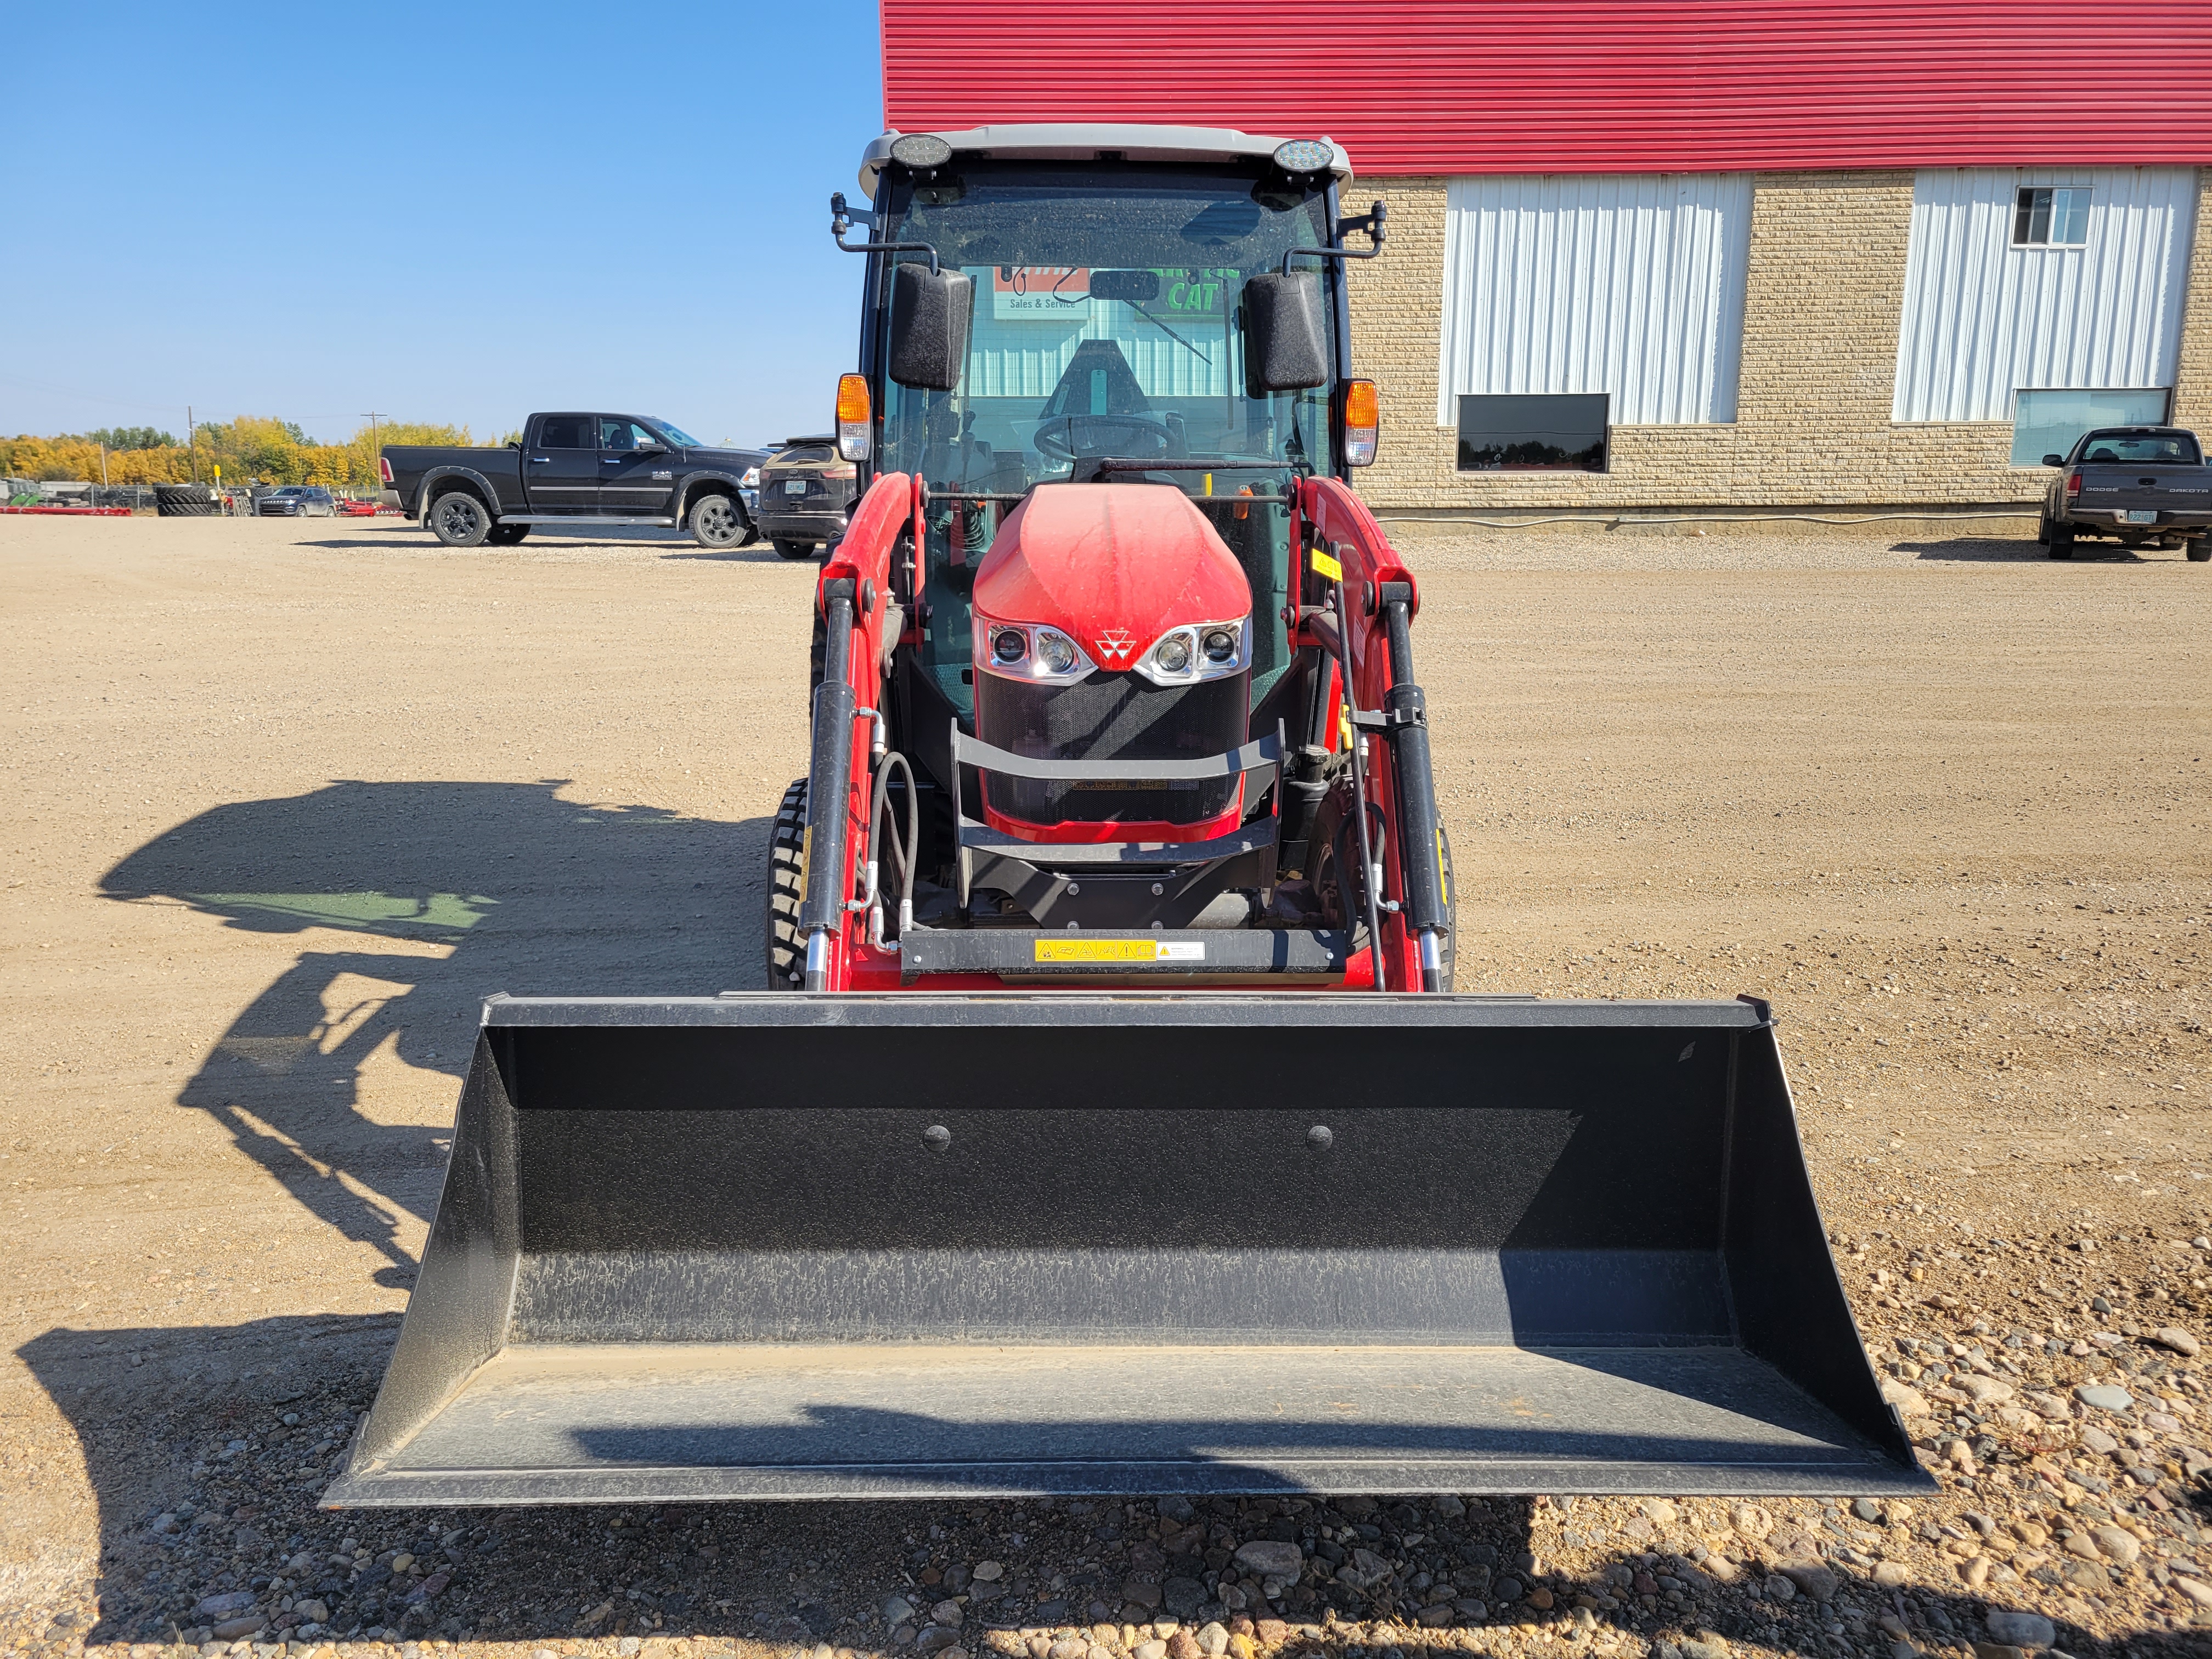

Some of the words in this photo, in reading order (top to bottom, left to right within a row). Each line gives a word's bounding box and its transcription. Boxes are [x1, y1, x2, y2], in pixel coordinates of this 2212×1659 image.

[1010, 298, 1032, 308] Sales
[1035, 298, 1042, 308] &
[1045, 298, 1075, 308] Service
[1167, 283, 1218, 310] CAT
